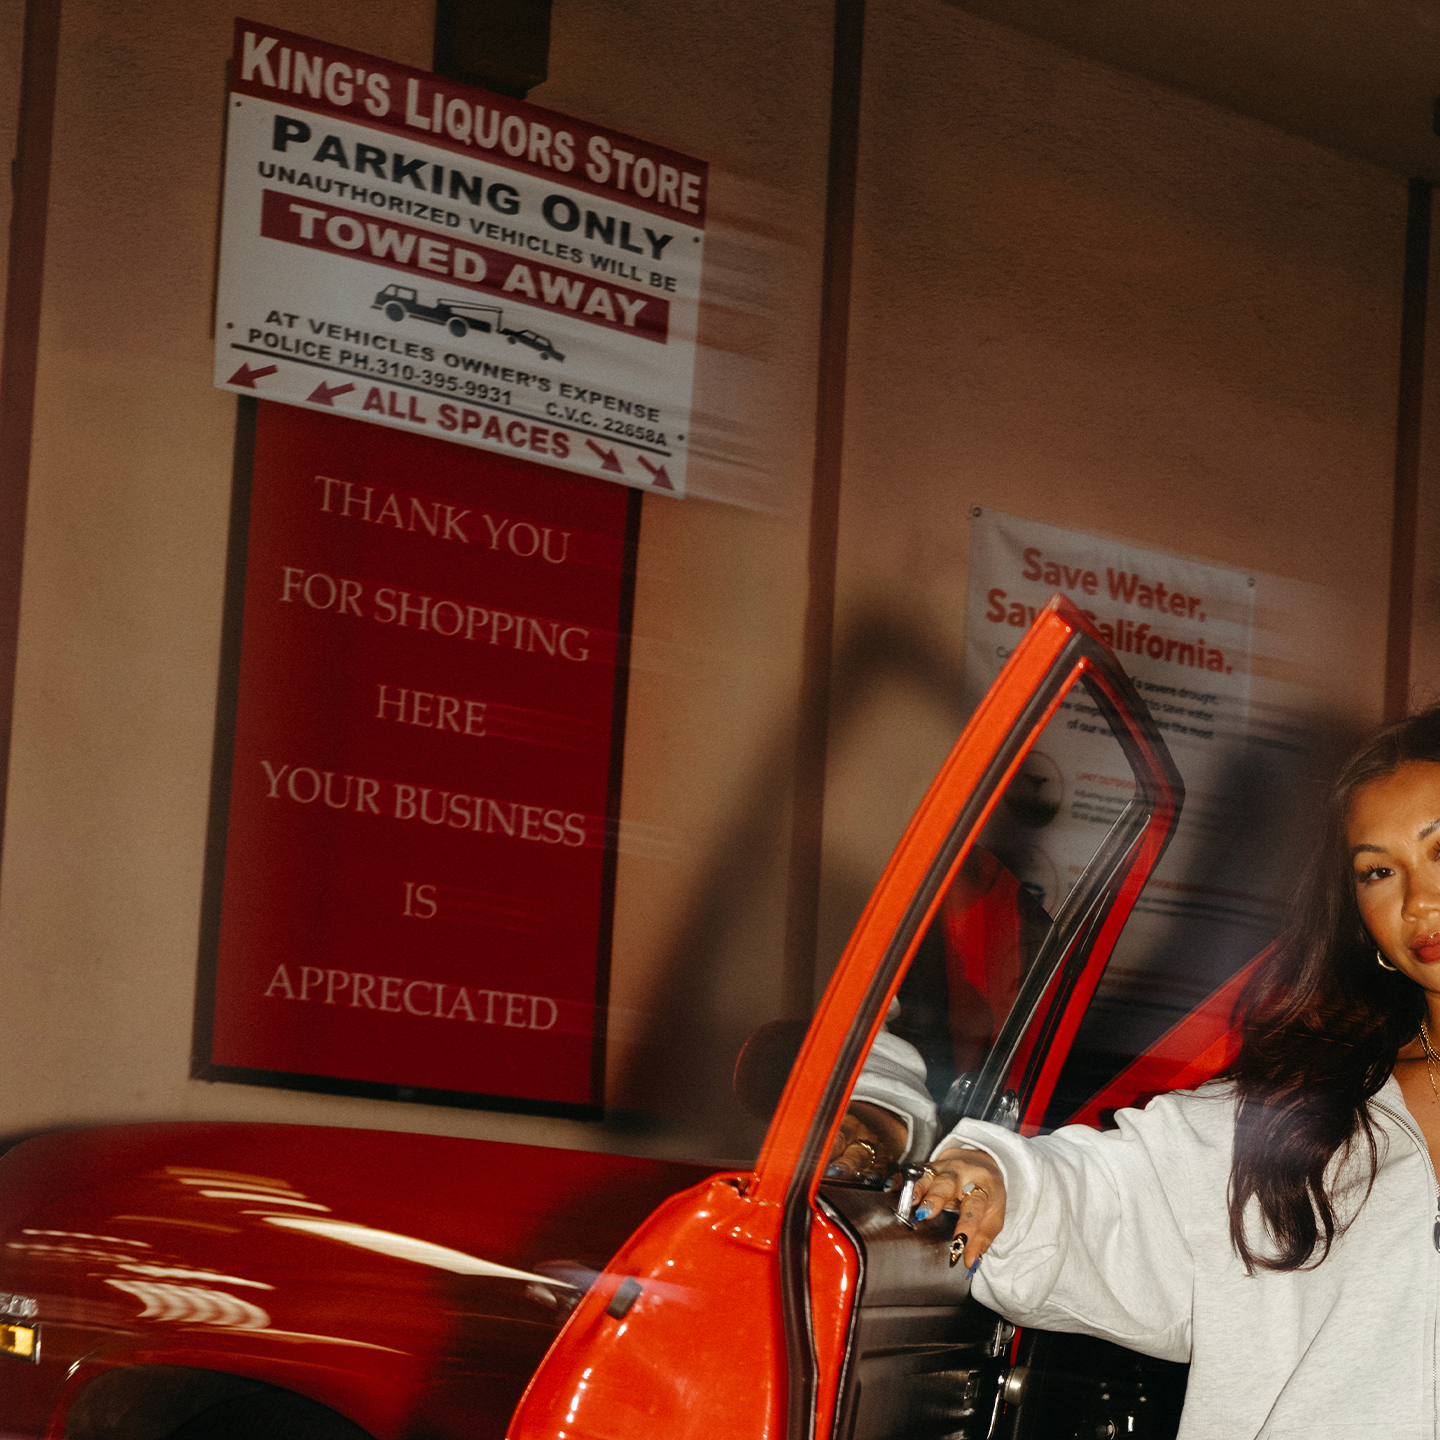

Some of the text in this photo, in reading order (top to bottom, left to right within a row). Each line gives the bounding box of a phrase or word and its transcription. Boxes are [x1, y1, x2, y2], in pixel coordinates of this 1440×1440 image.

[241, 31, 701, 214] KING'S LIQUORS STORE
[258, 161, 678, 293] UNAUTHORIZED VEHICLES WILL BE
[272, 114, 674, 261] PARKING ONLY
[289, 203, 648, 328] TOWED AWAY
[248, 328, 332, 361] POLICE
[545, 401, 598, 428] C.V.C.
[265, 310, 661, 423] AT VEHICLES OWNER'S EXPENSE
[363, 386, 571, 459] ALL SPACES
[315, 476, 571, 563] THANK YOU
[279, 566, 591, 661] FOR SHOPPING
[986, 588, 1043, 628] Sa
[1022, 547, 1207, 622] Save Water.
[375, 684, 488, 736] HERE
[261, 761, 587, 847] YOUR BUSINESS
[401, 882, 439, 918] IS
[264, 964, 559, 1030] APPRECIATED
